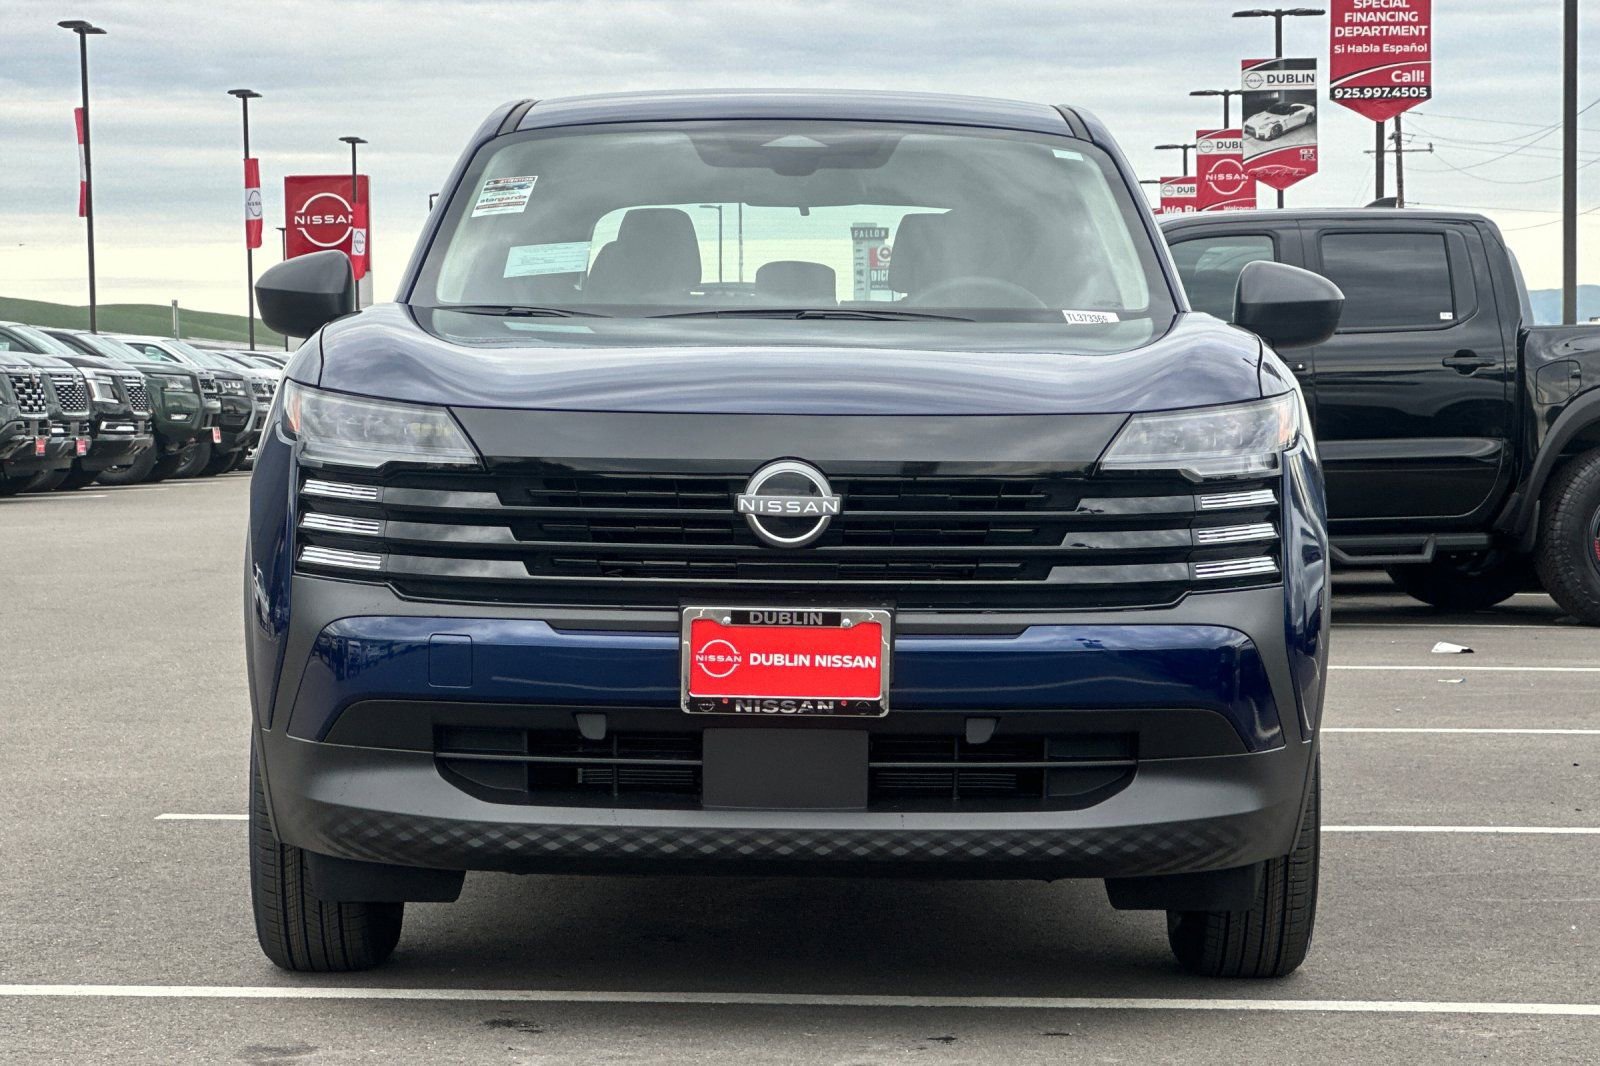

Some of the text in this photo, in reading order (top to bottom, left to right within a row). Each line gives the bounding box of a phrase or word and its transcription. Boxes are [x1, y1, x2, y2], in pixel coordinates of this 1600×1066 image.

[1353, 0, 1410, 8] SPECIAL
[1344, 11, 1418, 23] FINANCING
[1334, 25, 1428, 37] DEPARTMENT
[1347, 43, 1380, 53] Habla
[1382, 42, 1428, 54] Español
[1266, 73, 1315, 84] DUBLIN
[1391, 69, 1425, 83] Call!
[1334, 87, 1428, 99] 925.997.4505
[1216, 141, 1243, 149] DUBL
[1205, 173, 1249, 181] NISSAN
[1176, 186, 1196, 194] DUB
[740, 498, 838, 513] NISSAN
[749, 610, 823, 626] DUBLIN
[695, 654, 742, 662] NISSAN
[749, 653, 877, 669] DUBLIN NISSAN
[734, 699, 835, 714] NISSAN
